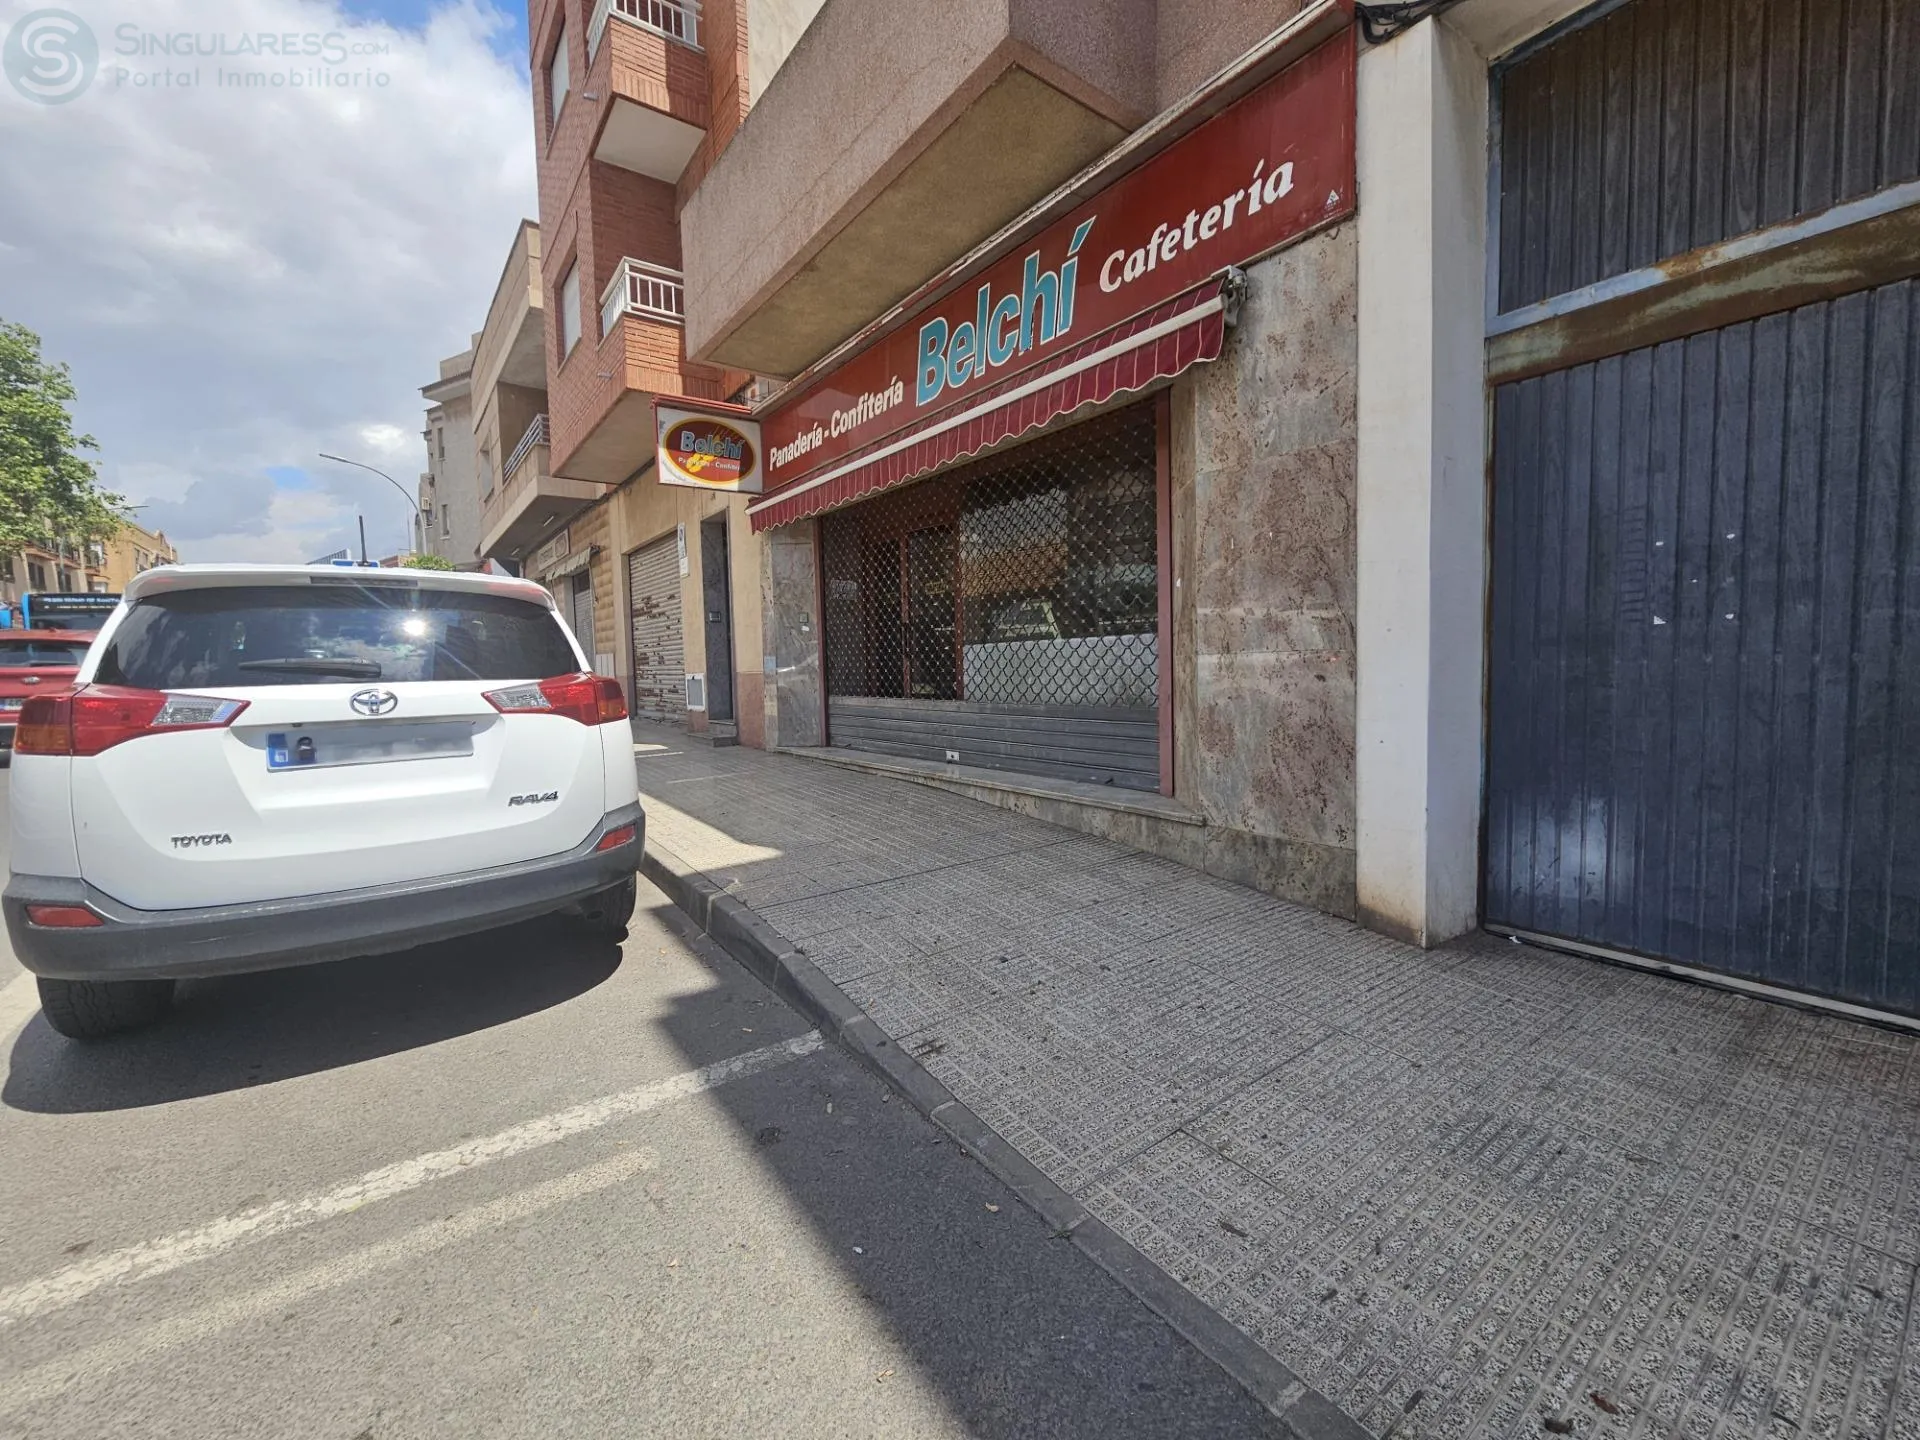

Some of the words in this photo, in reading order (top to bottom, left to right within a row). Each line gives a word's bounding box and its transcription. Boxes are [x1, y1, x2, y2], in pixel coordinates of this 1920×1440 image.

[1099, 158, 1294, 293] Cafetería
[916, 215, 1097, 407] Belchí
[680, 430, 745, 460] Belchí
[769, 421, 823, 472] Panadería
[830, 375, 903, 438] Confitería
[508, 790, 559, 807] RAV4
[170, 833, 233, 849] TOYOTA
